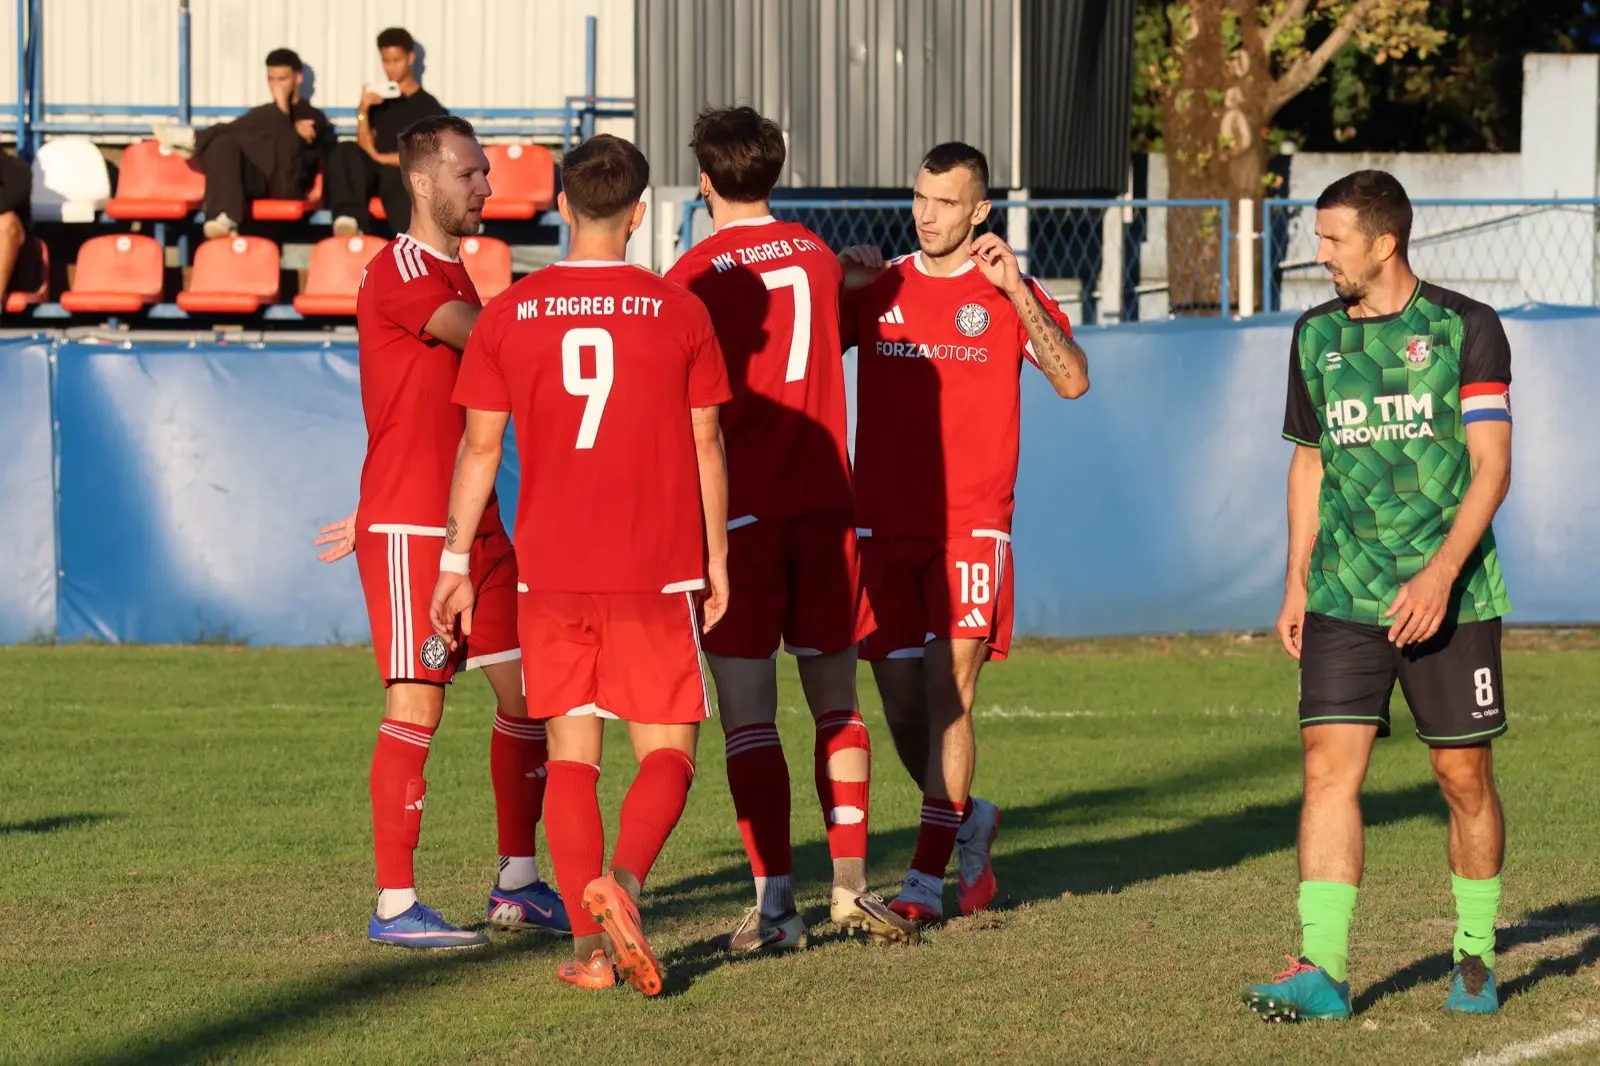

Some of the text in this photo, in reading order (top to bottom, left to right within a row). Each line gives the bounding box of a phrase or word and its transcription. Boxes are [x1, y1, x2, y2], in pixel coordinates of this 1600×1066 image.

[711, 252, 737, 273] NK
[736, 240, 793, 265] ZAGREB
[517, 296, 662, 321] NK ZAGREB CITY
[760, 265, 812, 383] 7
[876, 341, 988, 363] FORZAMOTORS
[562, 327, 614, 449] 9
[1326, 393, 1433, 428] HD TIM
[955, 561, 990, 604] 18
[1473, 667, 1493, 706] 8
